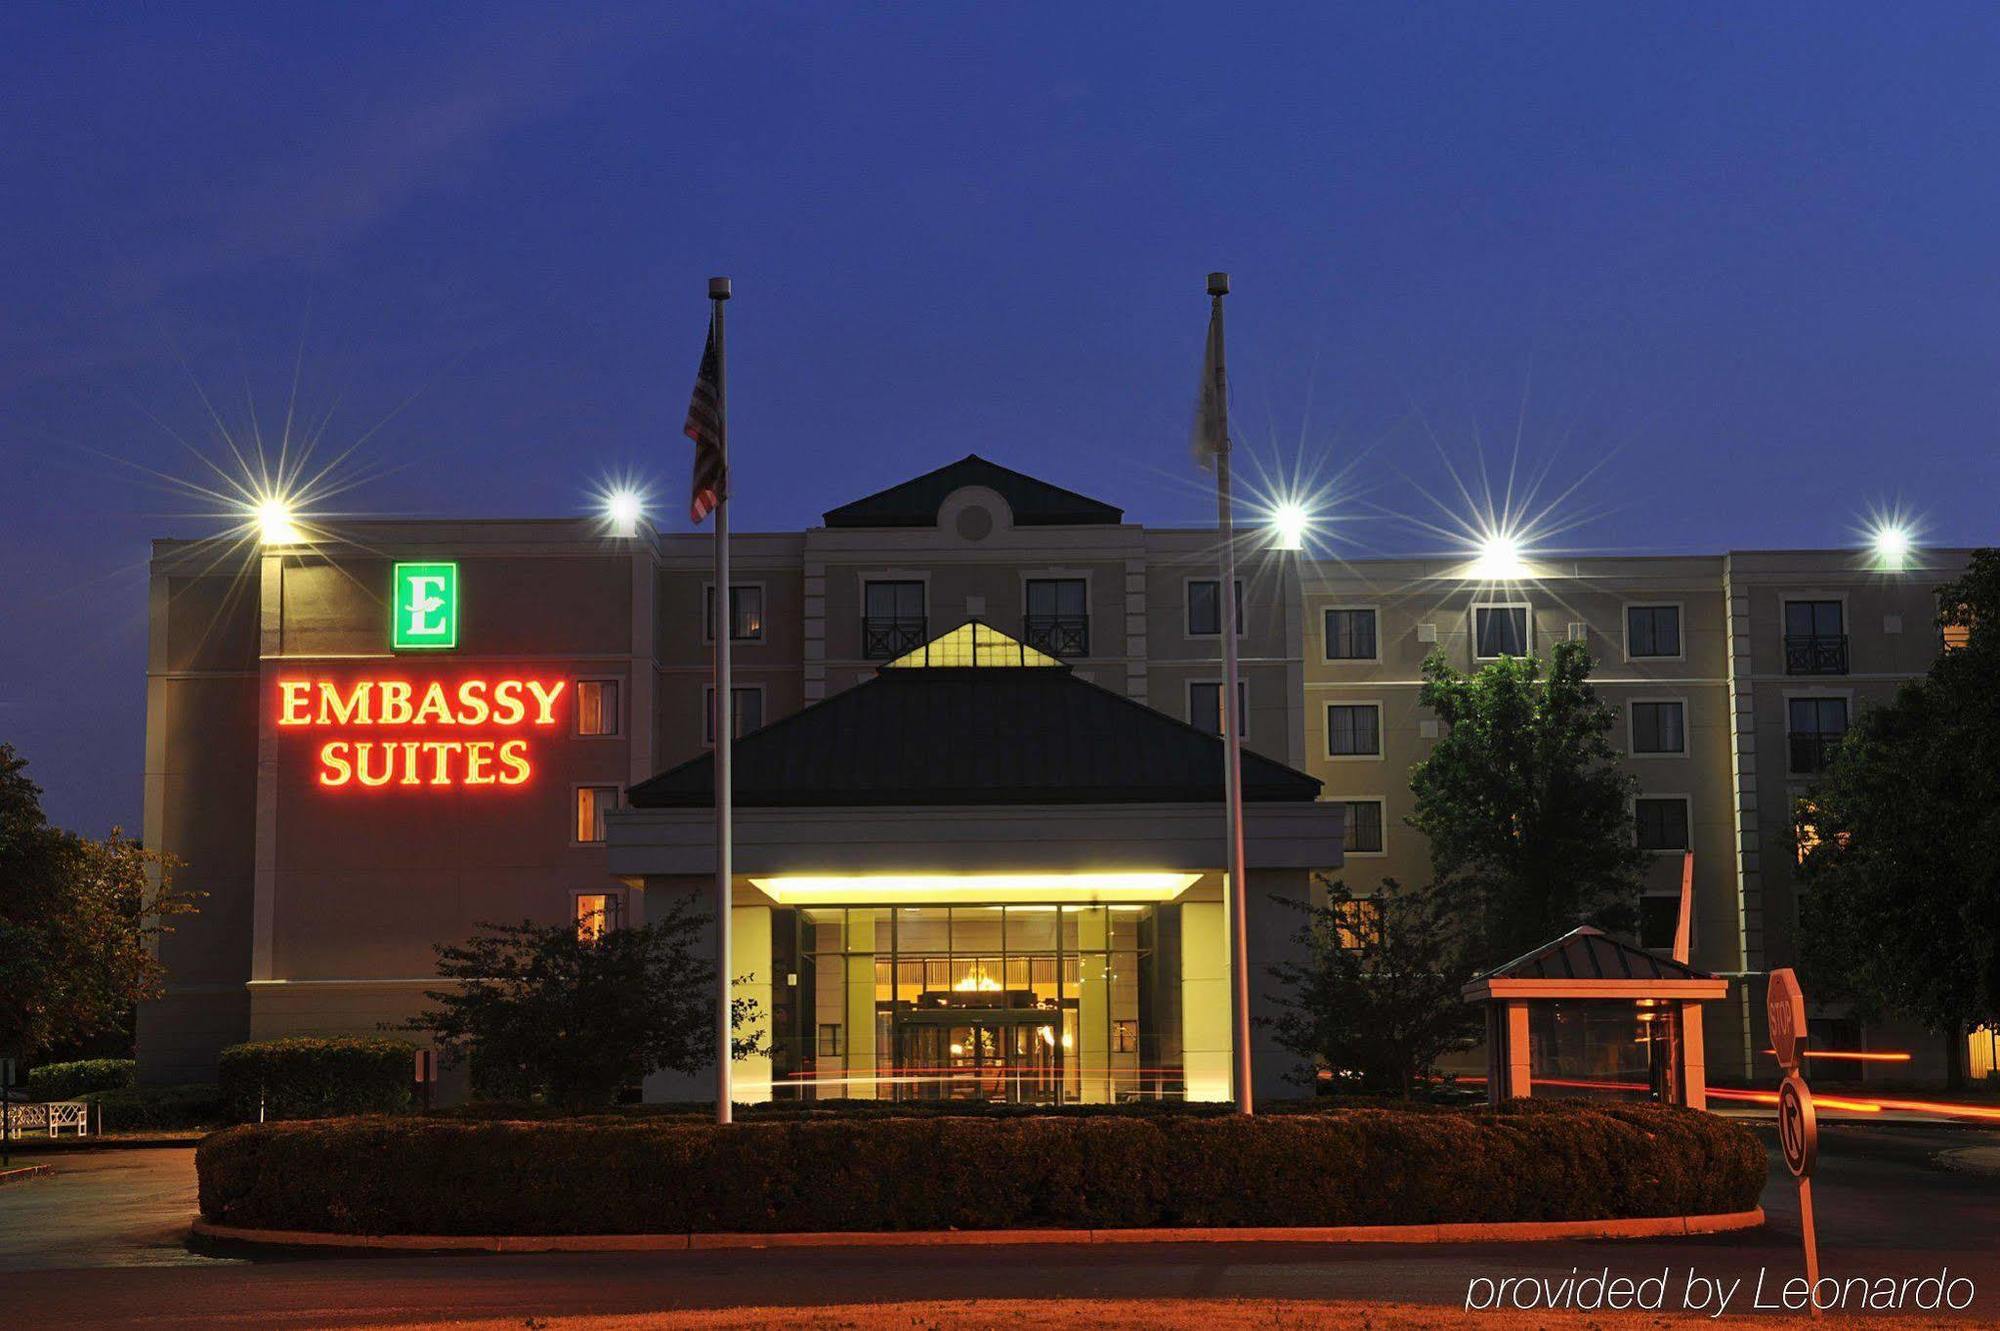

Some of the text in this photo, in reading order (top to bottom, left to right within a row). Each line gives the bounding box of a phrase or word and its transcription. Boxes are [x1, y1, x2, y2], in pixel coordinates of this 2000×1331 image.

[405, 576, 446, 635] E
[278, 680, 565, 726] EMBASSY
[319, 740, 531, 786] SUITES
[1770, 1000, 1792, 1037] STOP
